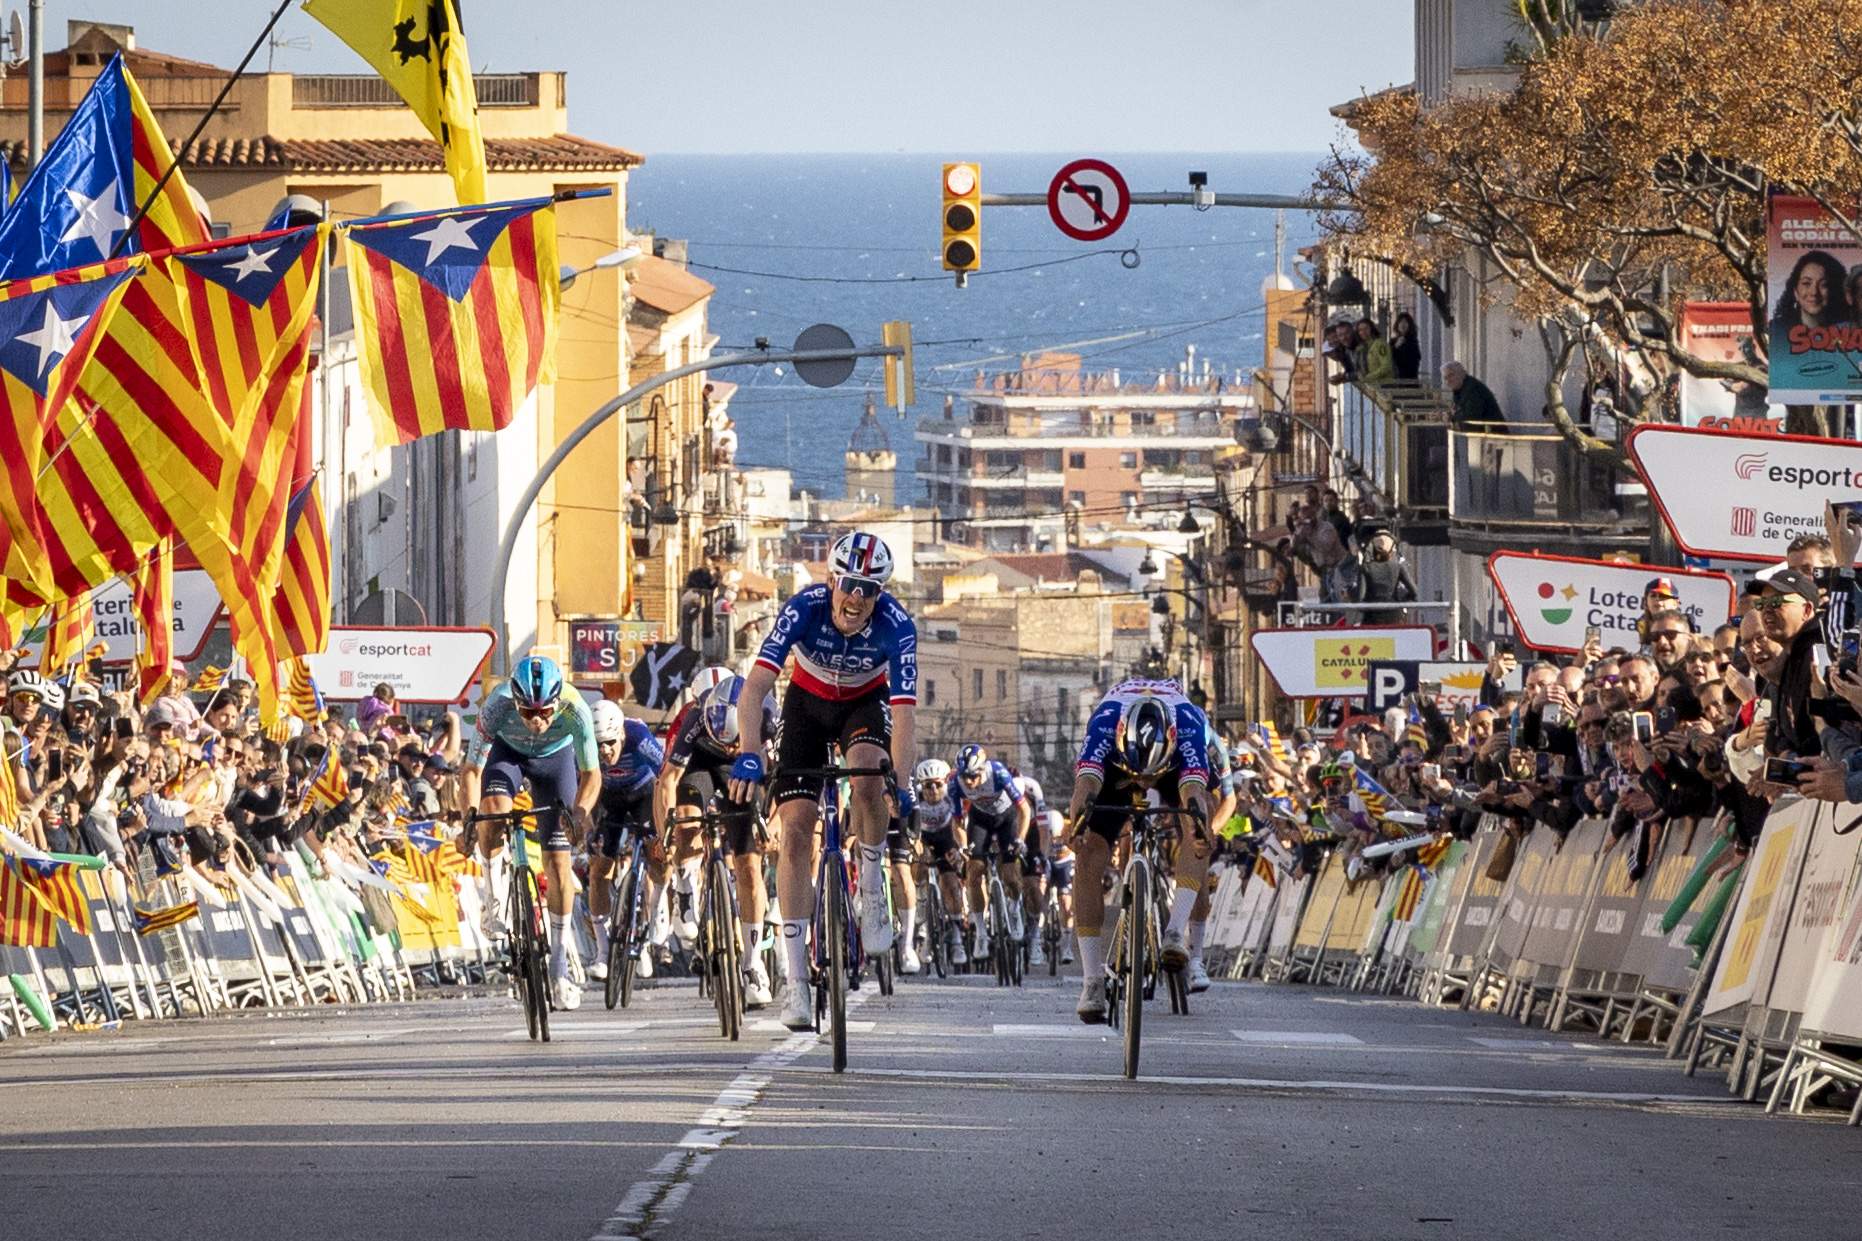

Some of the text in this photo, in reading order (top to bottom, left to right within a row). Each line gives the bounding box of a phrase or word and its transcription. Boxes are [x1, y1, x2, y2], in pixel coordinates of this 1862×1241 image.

[1763, 511, 1824, 527] Generali
[1762, 527, 1780, 539] de
[94, 593, 134, 615] teri
[1685, 604, 1704, 616] de
[576, 629, 659, 641] PINTORES
[762, 605, 799, 658] INEOS
[359, 644, 432, 658] esportcat
[808, 650, 874, 670] INEOS
[900, 634, 916, 691] INEOS
[357, 671, 403, 680] Generalitat
[357, 681, 368, 689] de
[1375, 668, 1405, 708] P
[1179, 740, 1202, 768] BOSS
